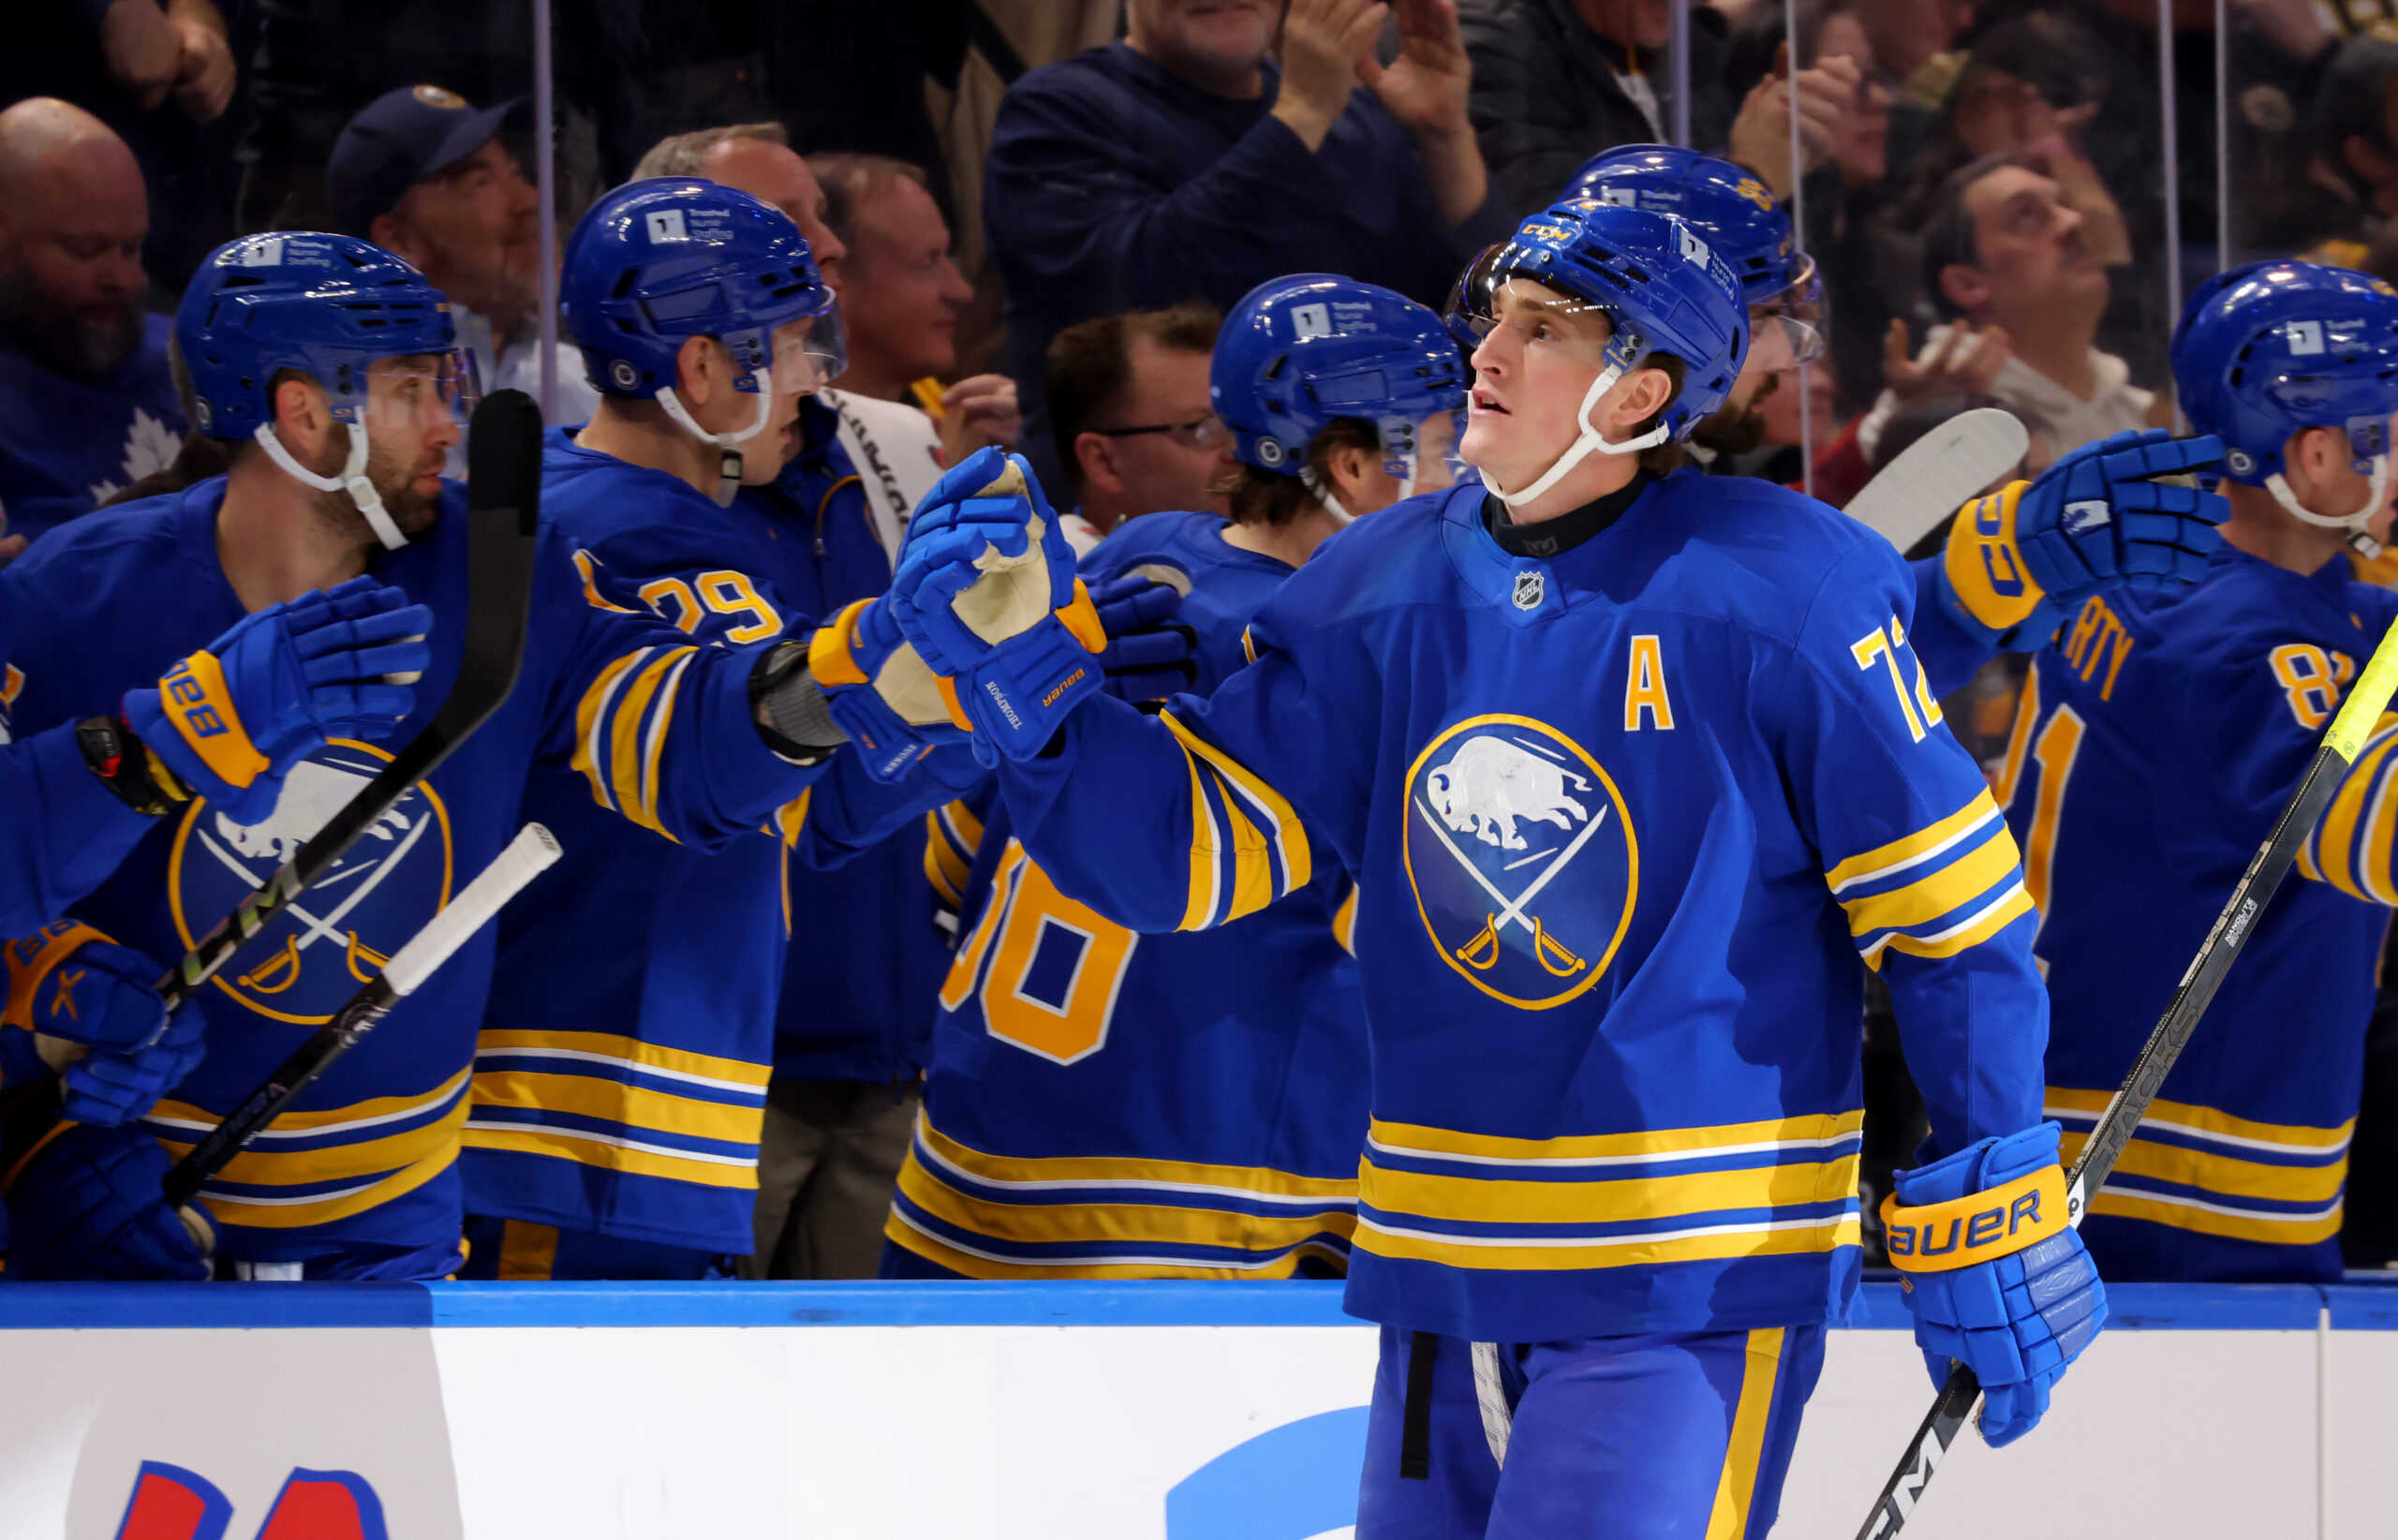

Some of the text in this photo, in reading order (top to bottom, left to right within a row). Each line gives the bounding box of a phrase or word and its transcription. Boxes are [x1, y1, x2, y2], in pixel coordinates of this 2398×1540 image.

[1518, 582, 1538, 601] NHL
[984, 681, 1023, 730] THOMPSON
[1624, 634, 1675, 732] A
[2225, 896, 2253, 942] NANOLITE
[2092, 1000, 2199, 1164] TACKS
